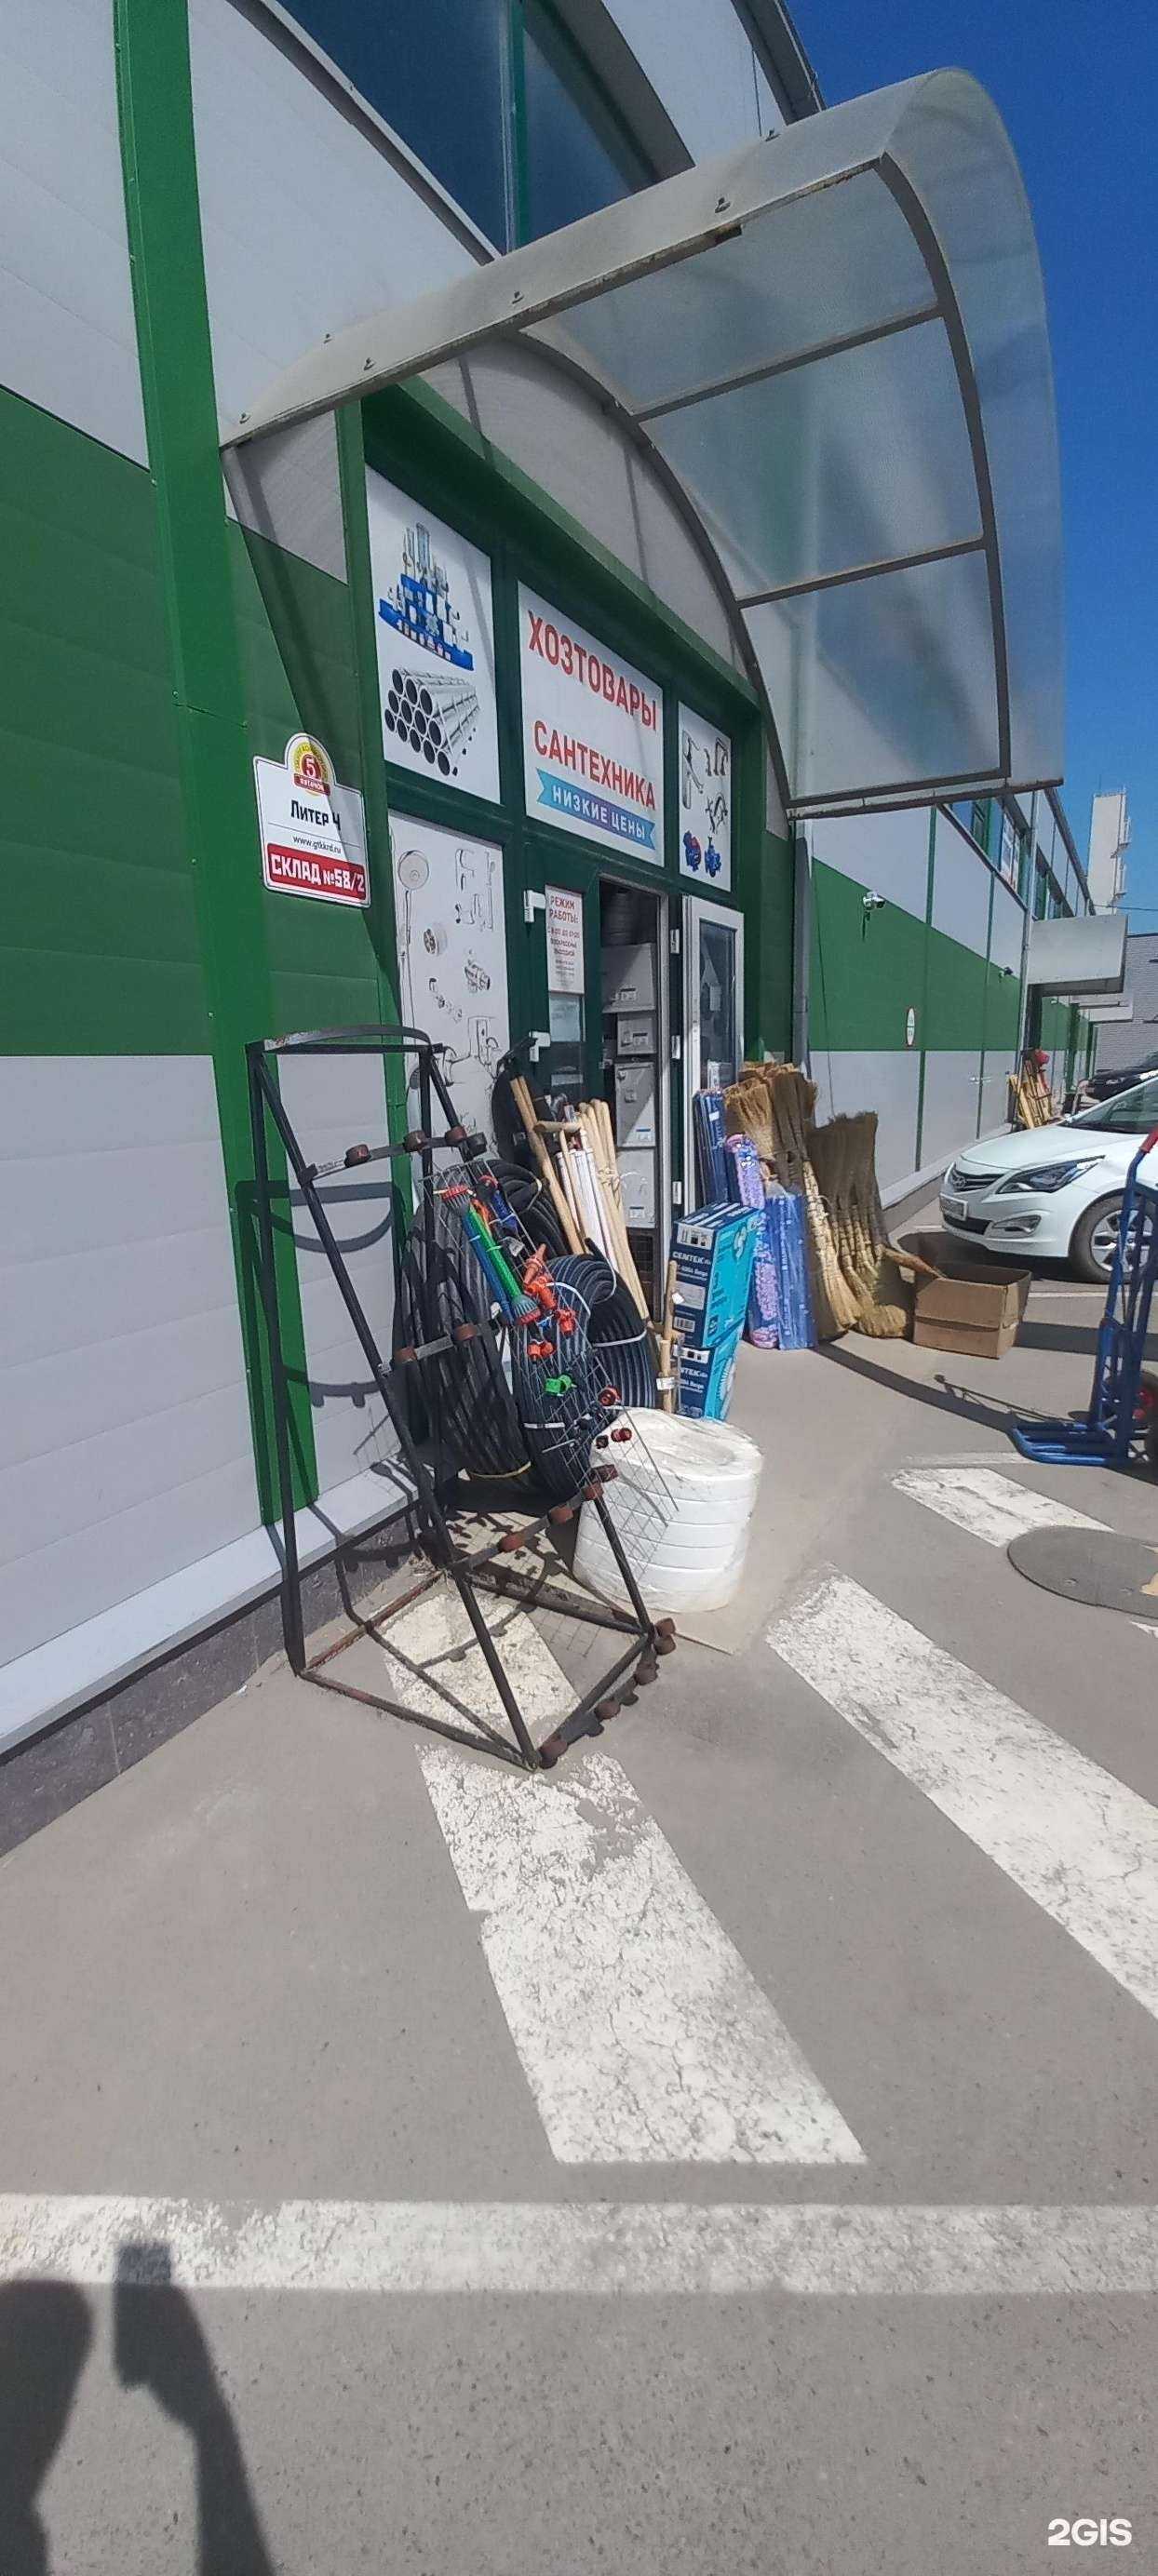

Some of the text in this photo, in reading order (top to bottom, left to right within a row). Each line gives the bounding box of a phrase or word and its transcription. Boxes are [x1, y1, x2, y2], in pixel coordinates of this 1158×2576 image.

[528, 610, 657, 732] ХОЗТОВАРЫ
[305, 757, 316, 779] 5
[533, 719, 656, 812] САНТЕХНИКА
[552, 785, 646, 840] НИЗКИЕ ЦЕНЫ
[270, 852, 365, 893] СКЛАД №58/2
[550, 894, 575, 910] РЕЖИМ
